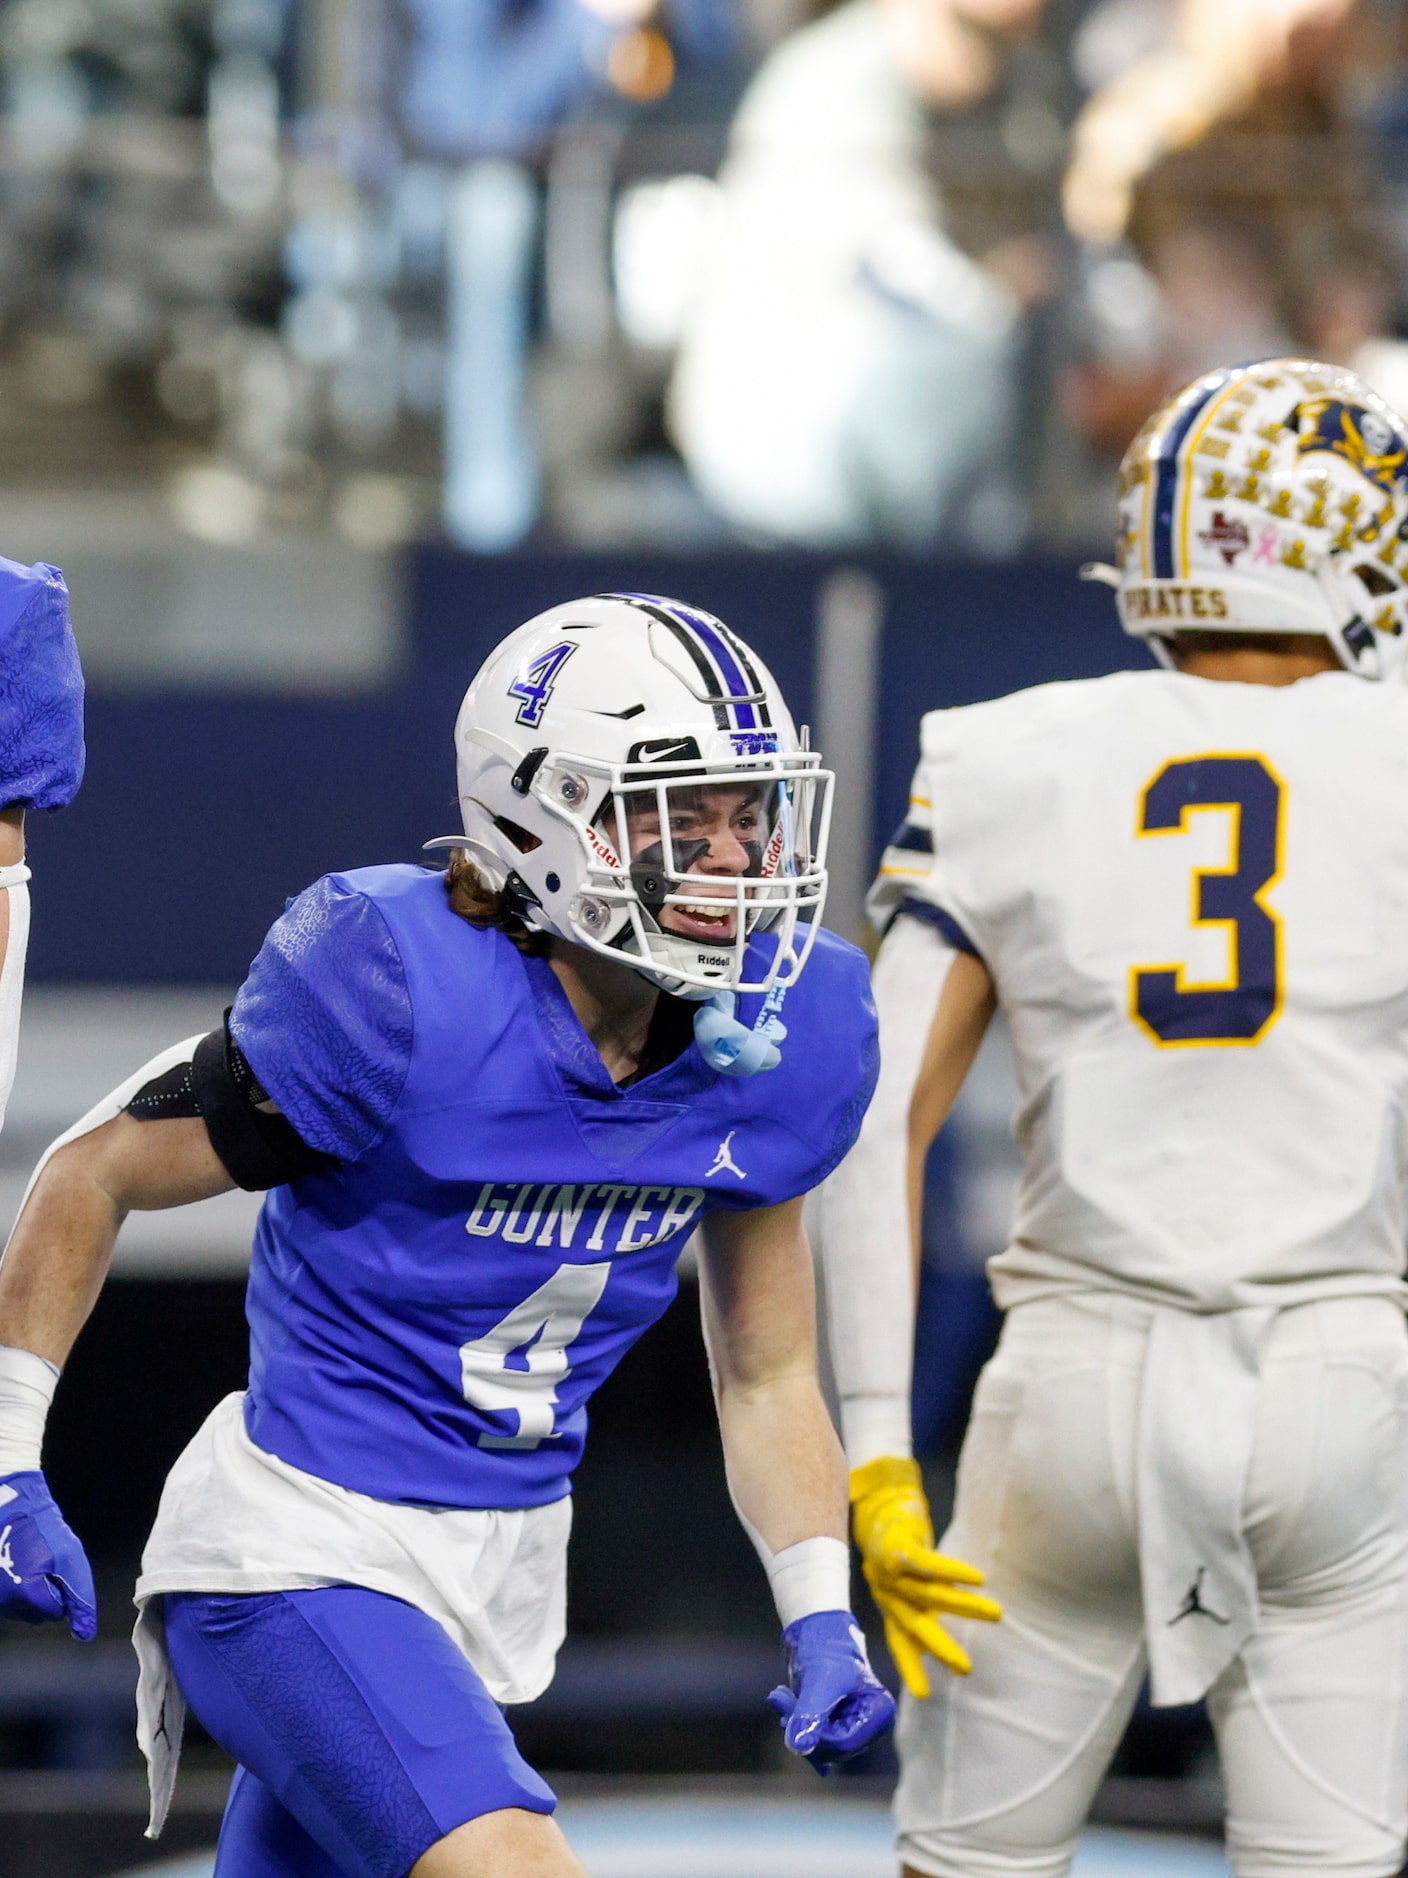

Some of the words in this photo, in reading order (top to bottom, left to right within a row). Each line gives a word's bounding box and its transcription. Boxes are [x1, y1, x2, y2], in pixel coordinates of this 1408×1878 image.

[507, 640, 580, 729] 4
[697, 954, 730, 966] Riddell
[1129, 750, 1289, 1049] 3
[459, 1262, 612, 1449] 4
